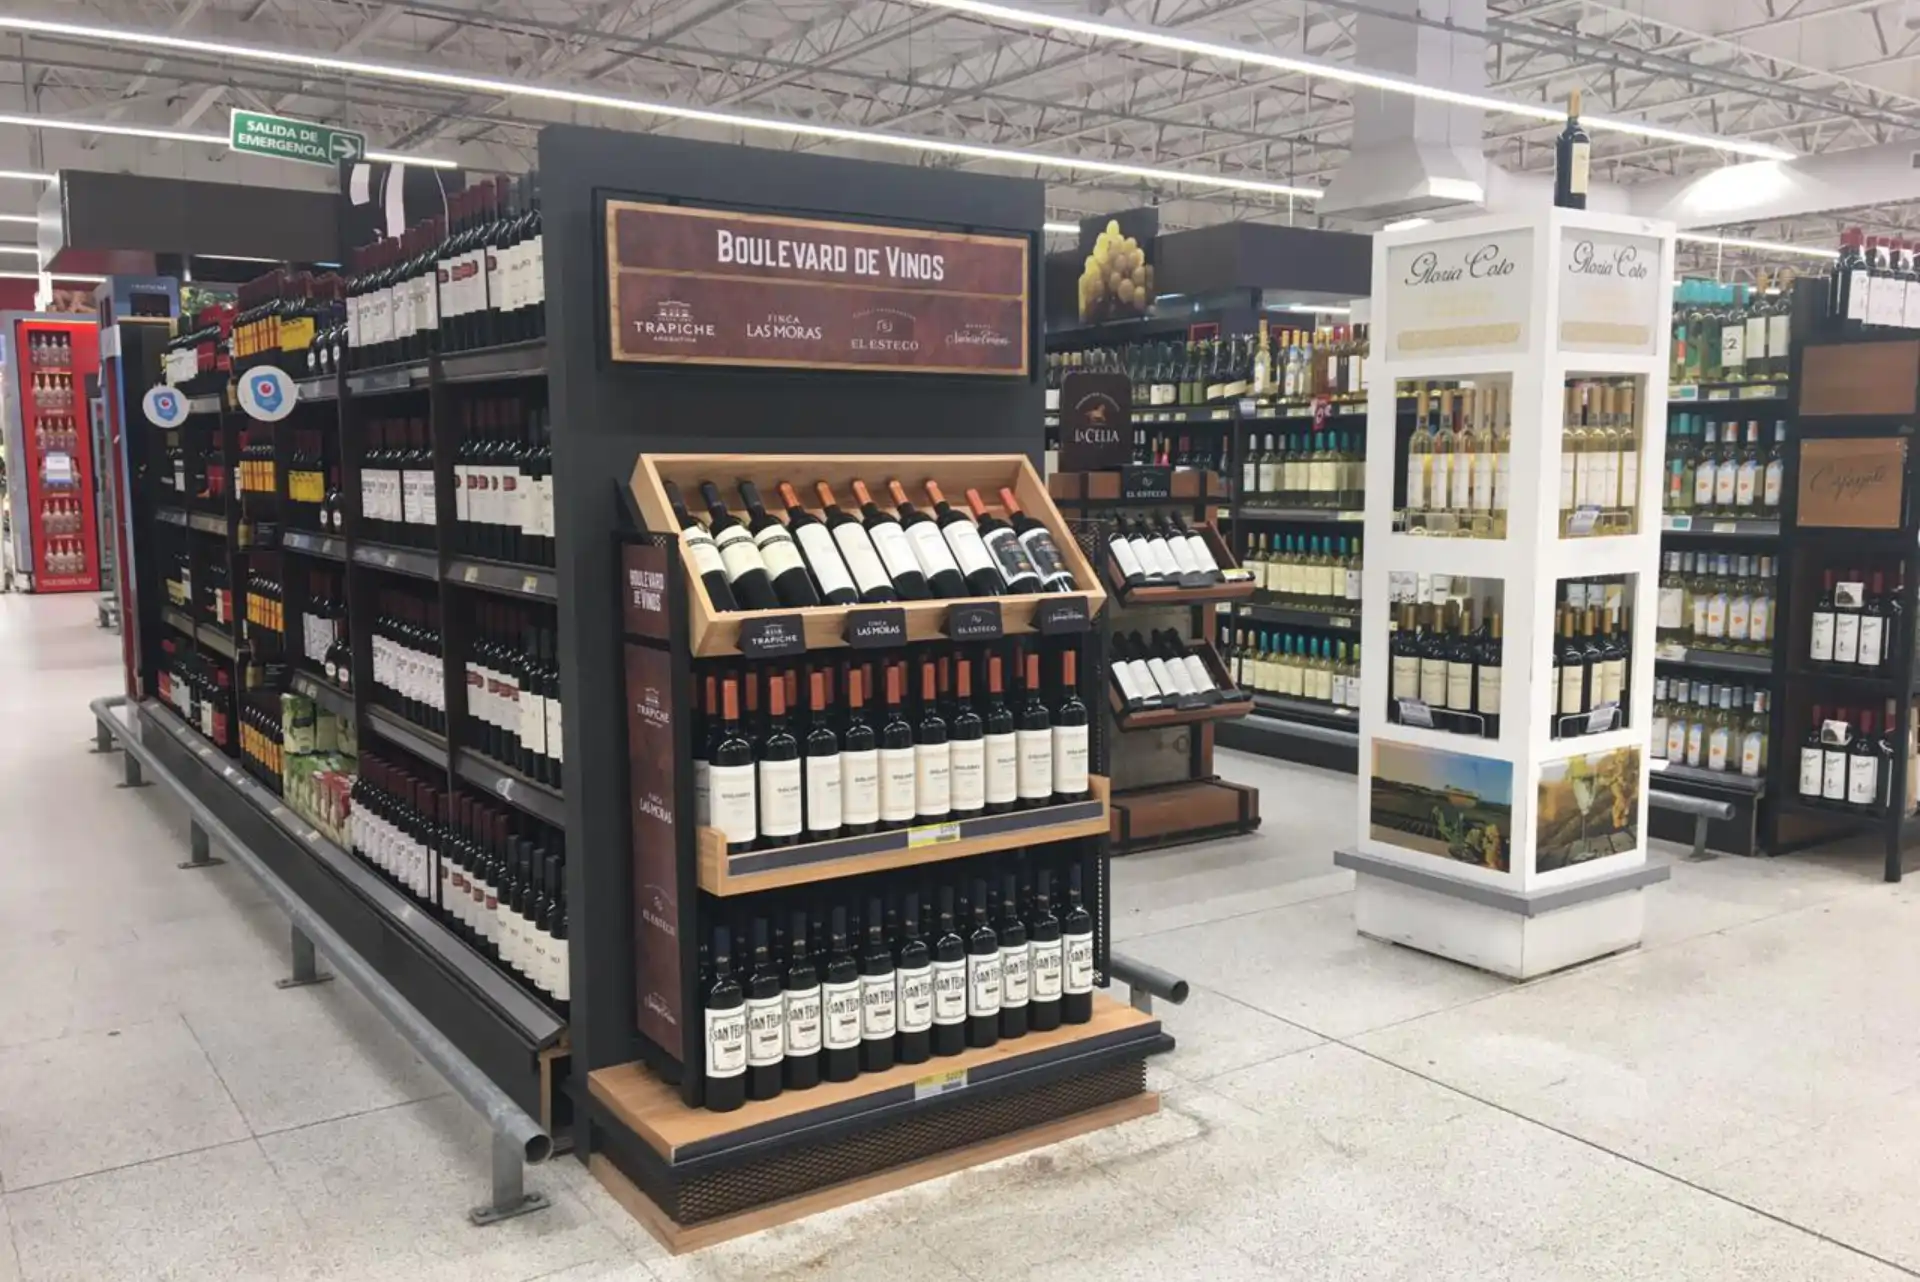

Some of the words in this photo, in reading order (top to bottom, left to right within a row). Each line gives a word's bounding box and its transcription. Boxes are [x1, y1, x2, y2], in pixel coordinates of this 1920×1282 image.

[247, 120, 297, 139] SALIDA
[300, 130, 319, 142] DE
[238, 132, 327, 158] EMERGENCIA
[716, 229, 847, 273] BOULEVARD
[855, 248, 880, 275] DE
[886, 246, 944, 281] VINOS
[1568, 240, 1613, 278] Gloria
[1404, 250, 1463, 286] Gloria
[633, 321, 716, 337] TRAPICHE
[767, 313, 801, 325] FINCA
[746, 323, 771, 338] LAS
[773, 325, 822, 341] MORAS
[851, 338, 868, 350] EL
[870, 339, 919, 351] ESTECO
[641, 589, 661, 611] VINOS
[751, 634, 798, 646] TRAPICHE
[856, 627, 872, 636] LAS
[872, 625, 900, 635] MORAS
